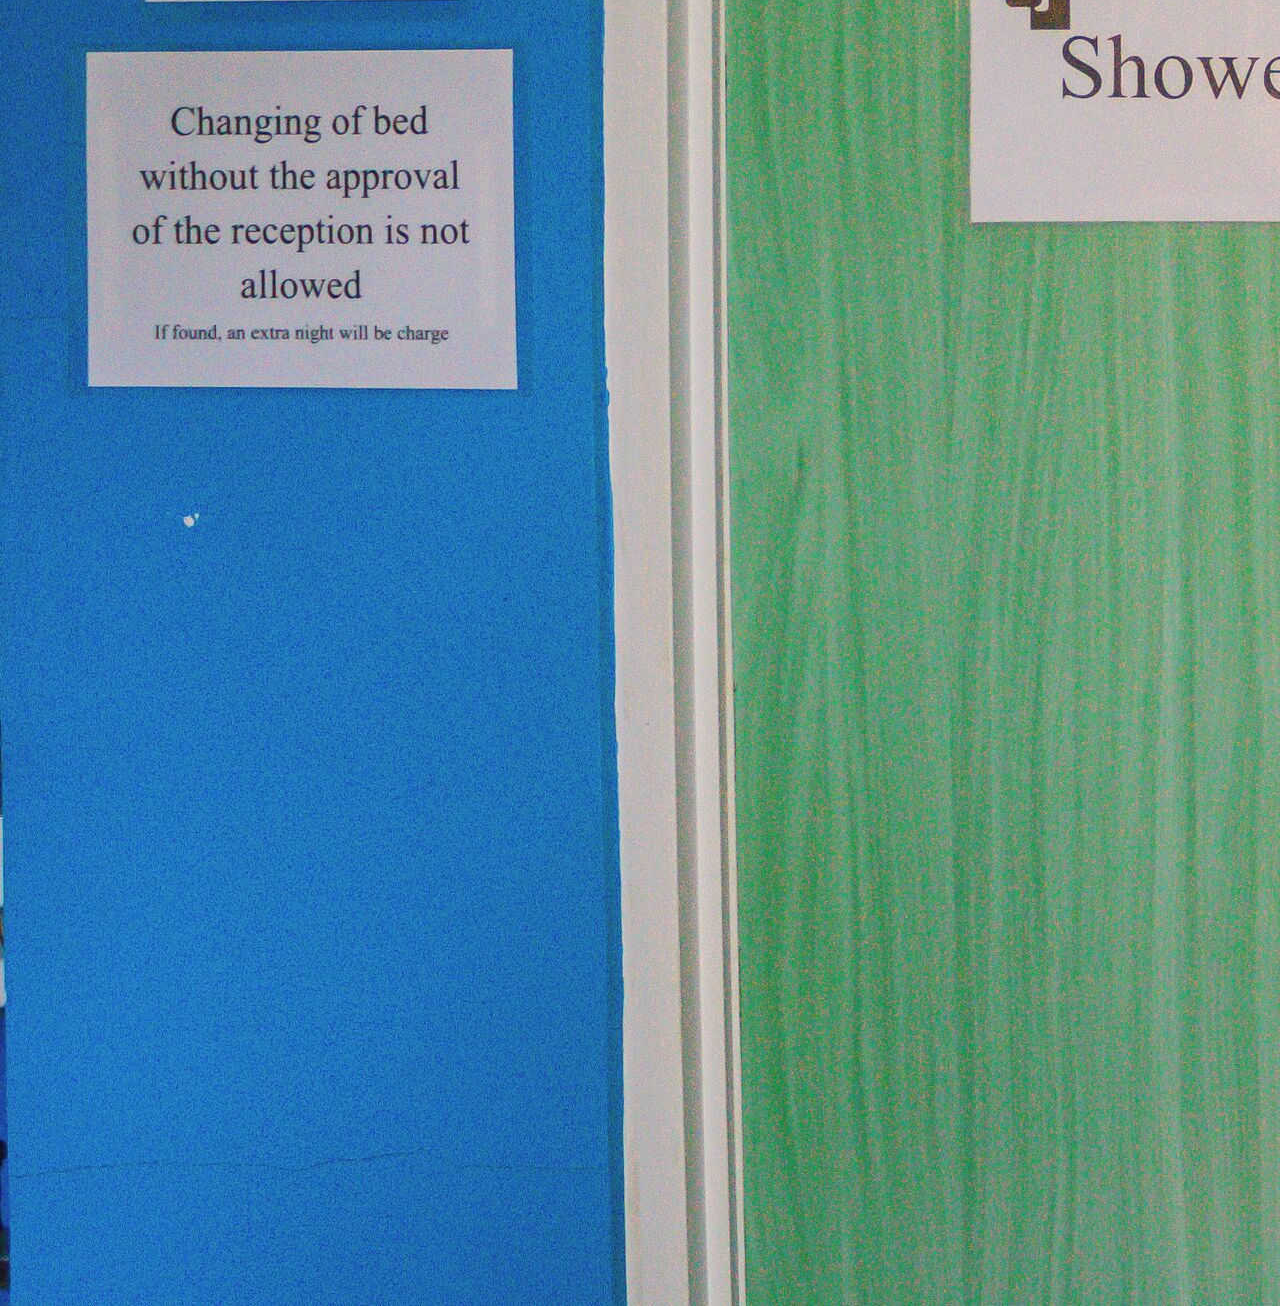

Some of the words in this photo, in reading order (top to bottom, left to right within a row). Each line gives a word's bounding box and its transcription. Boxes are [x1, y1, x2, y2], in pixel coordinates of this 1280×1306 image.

[170, 105, 322, 143] Changing
[331, 104, 367, 136] of
[373, 104, 429, 136] bed
[139, 160, 259, 191] without
[269, 159, 316, 191] the
[325, 159, 460, 199] approval
[131, 214, 168, 245] of
[173, 214, 221, 246] the
[231, 214, 373, 254] reception
[385, 214, 410, 245] is
[420, 220, 470, 245] not
[240, 268, 362, 300] allowed
[154, 323, 170, 340] If
[172, 323, 222, 343] found,
[226, 328, 246, 341] an
[250, 327, 291, 342] extra
[294, 324, 334, 346] night
[338, 324, 369, 341] will
[373, 325, 393, 341] be
[396, 325, 449, 345] charge
